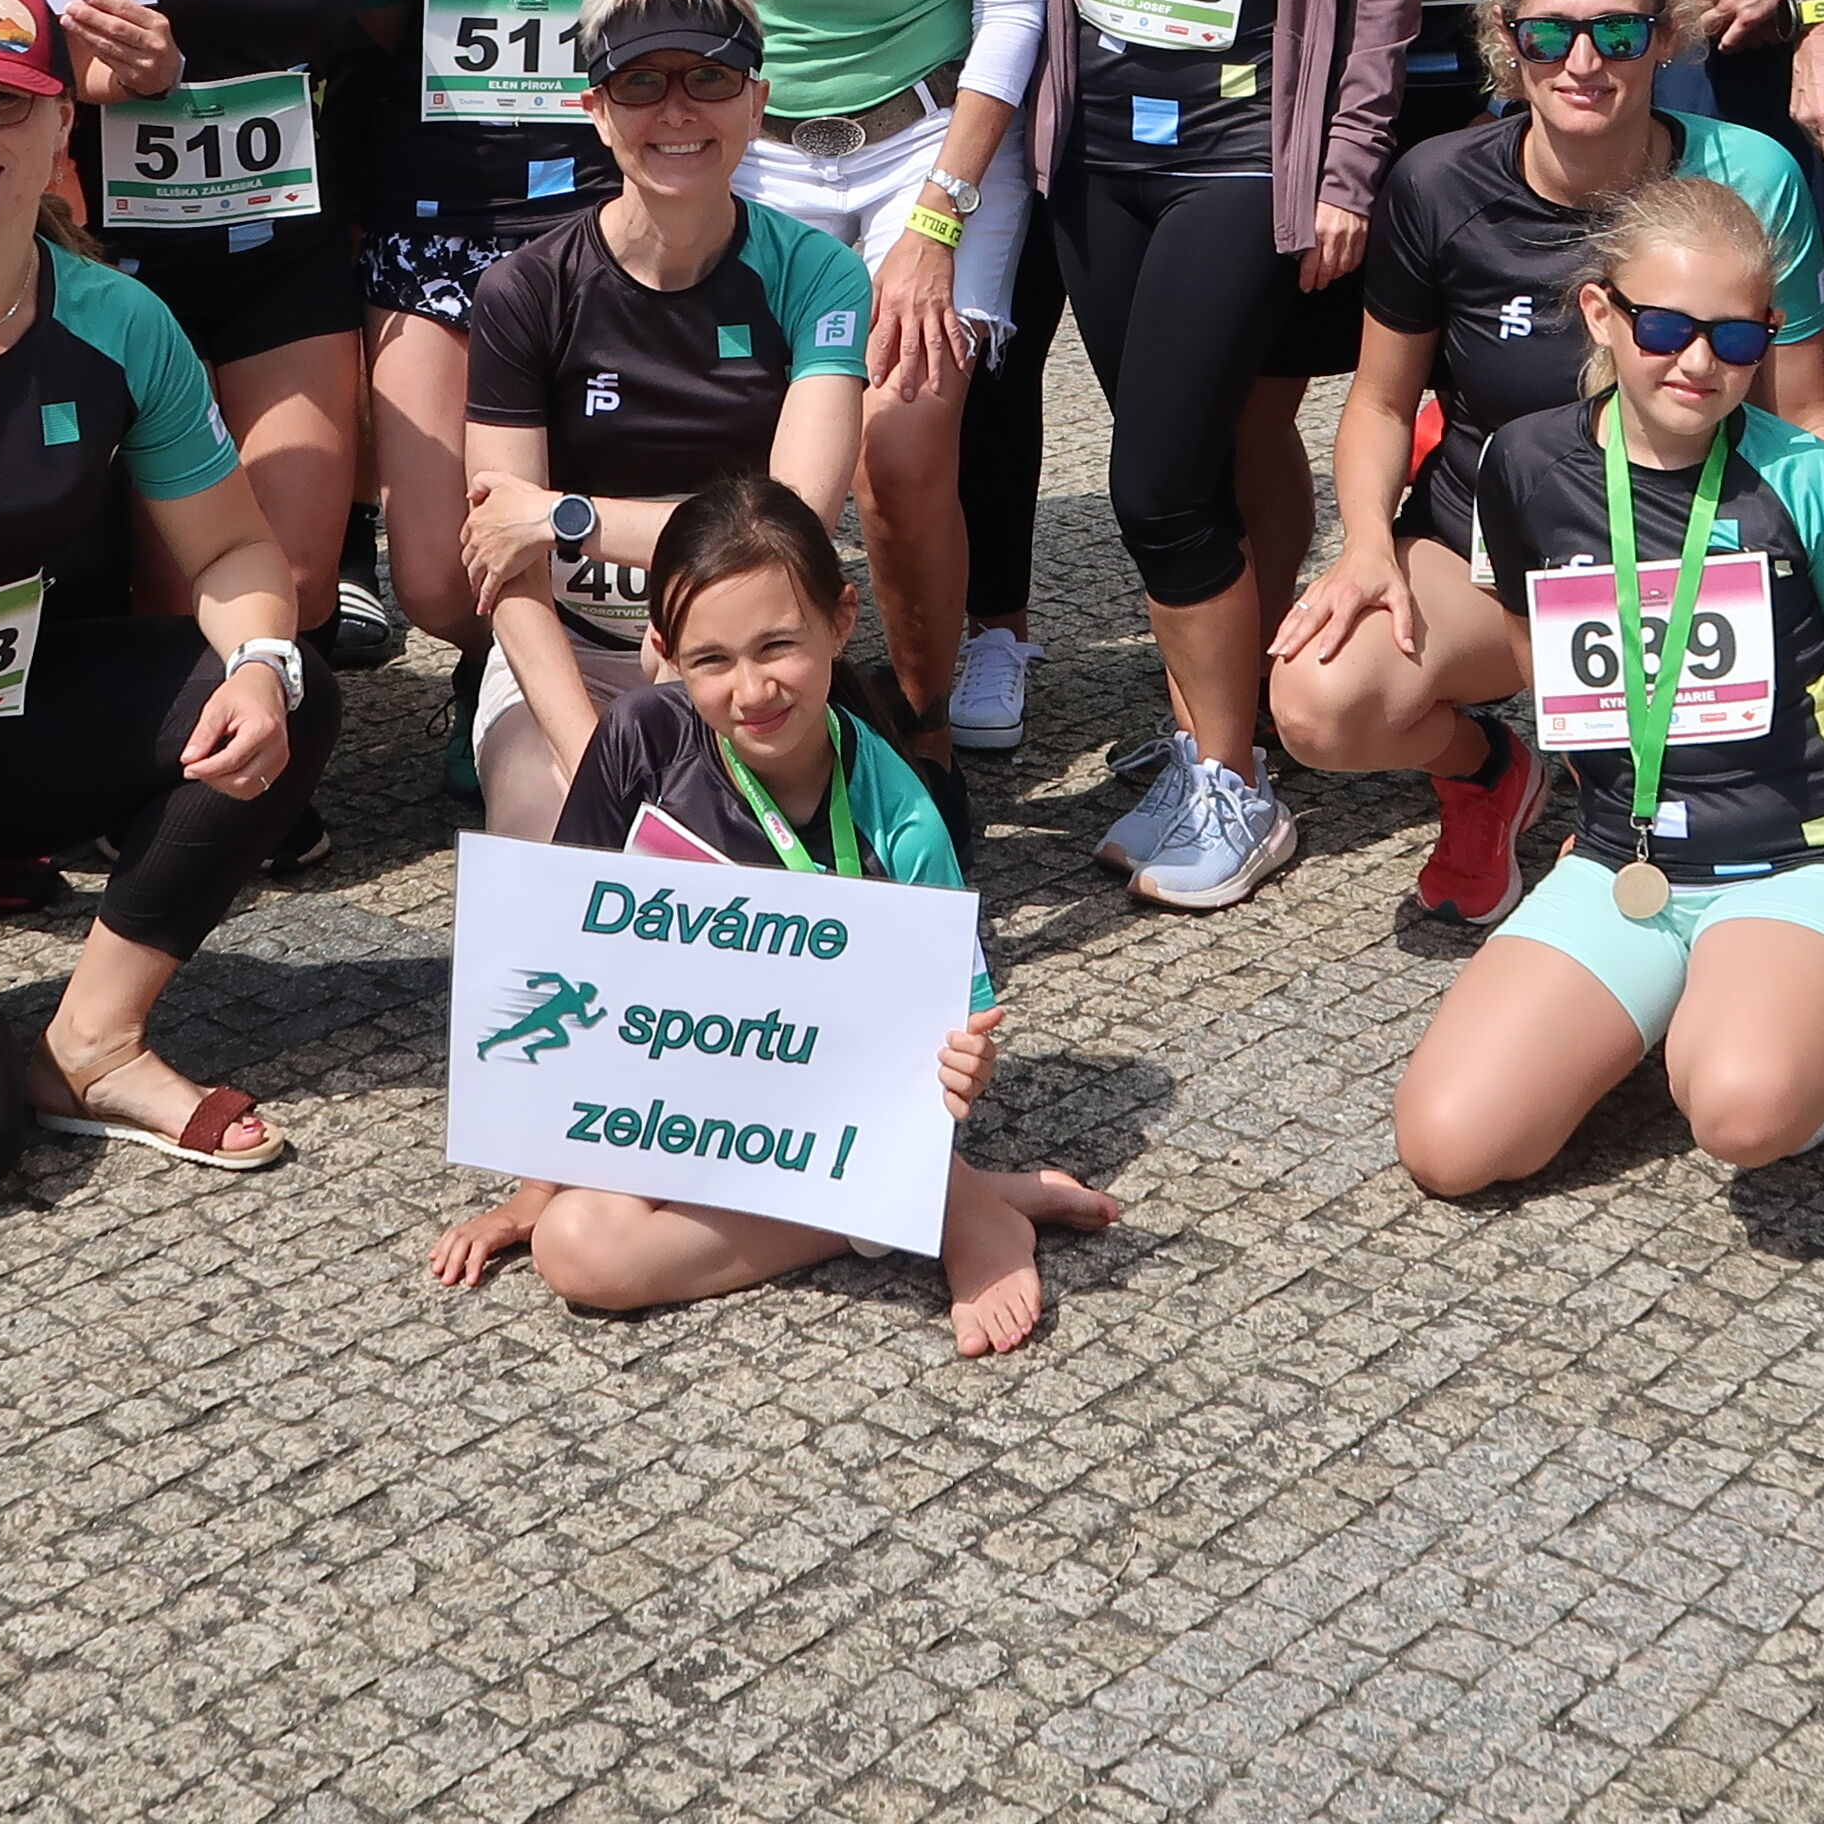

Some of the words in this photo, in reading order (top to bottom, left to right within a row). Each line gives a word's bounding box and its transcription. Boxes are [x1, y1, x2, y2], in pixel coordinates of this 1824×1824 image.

[1136, 0, 1174, 15] JOSEF
[454, 17, 589, 73] 511
[488, 80, 518, 89] ELEN
[134, 117, 282, 180] 510
[156, 186, 199, 197] ELIŠKA
[1571, 612, 1736, 688] 639
[1676, 690, 1715, 704] MARIE
[582, 880, 848, 960] Dáváme
[617, 1001, 820, 1066] sportu
[566, 1099, 816, 1173] zelenou
[831, 1125, 858, 1179] !
